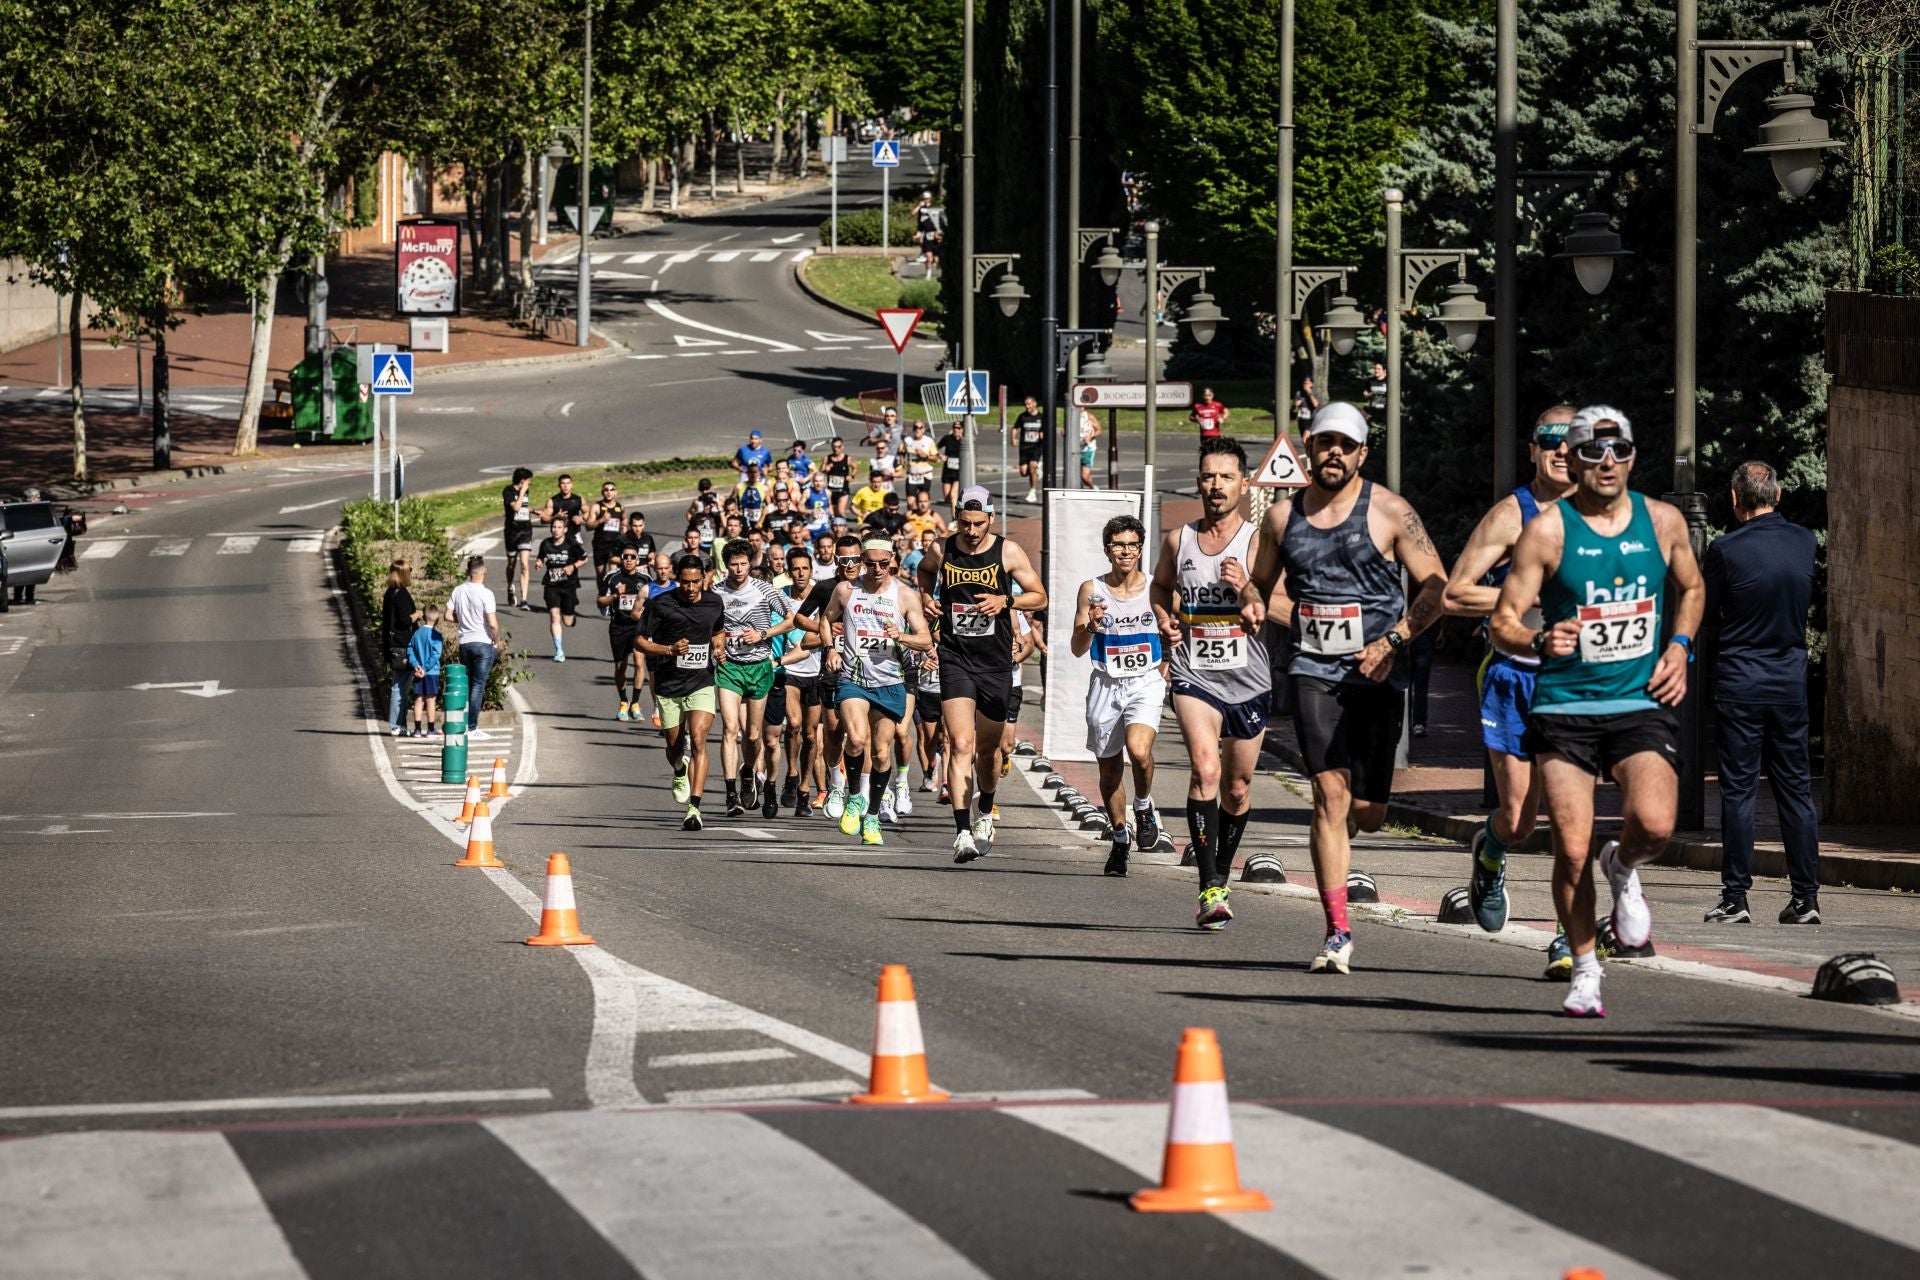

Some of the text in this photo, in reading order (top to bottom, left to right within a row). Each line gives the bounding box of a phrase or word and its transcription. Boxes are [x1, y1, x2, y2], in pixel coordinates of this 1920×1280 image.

[401, 242, 453, 256] McFlurry
[944, 562, 1000, 589] TITOBOX
[956, 614, 990, 628] 273
[1306, 620, 1352, 640] 471
[1589, 617, 1648, 646] 373
[727, 637, 742, 648] 41
[860, 637, 888, 650] 221
[1196, 639, 1238, 658] 251
[682, 652, 707, 662] 1205
[1112, 653, 1148, 668] 169
